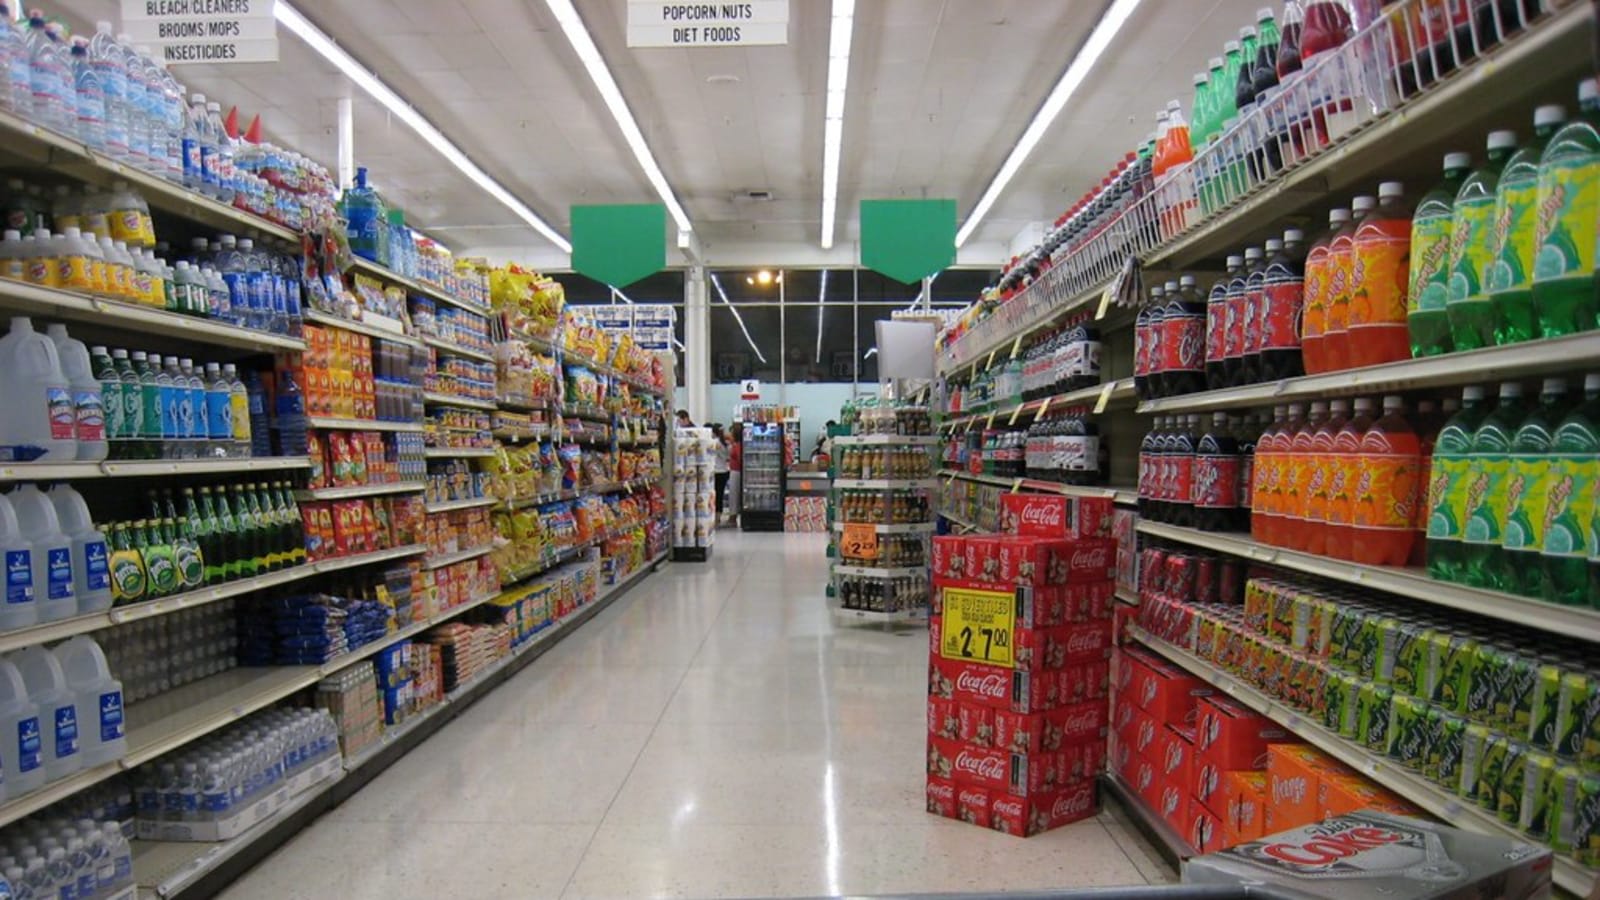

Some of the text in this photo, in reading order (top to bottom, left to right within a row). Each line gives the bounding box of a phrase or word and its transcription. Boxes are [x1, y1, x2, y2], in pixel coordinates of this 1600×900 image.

[147, 0, 249, 15] BLEACH/CLEANERS
[663, 4, 752, 20] POPCORN/NUTS
[159, 22, 240, 38] BROOMS/MOPS
[673, 27, 740, 43] DIET FOODS
[165, 45, 236, 60] INSECTICIDES
[746, 382, 754, 393] 6
[961, 625, 973, 657] 2
[1262, 827, 1402, 866] Coke
